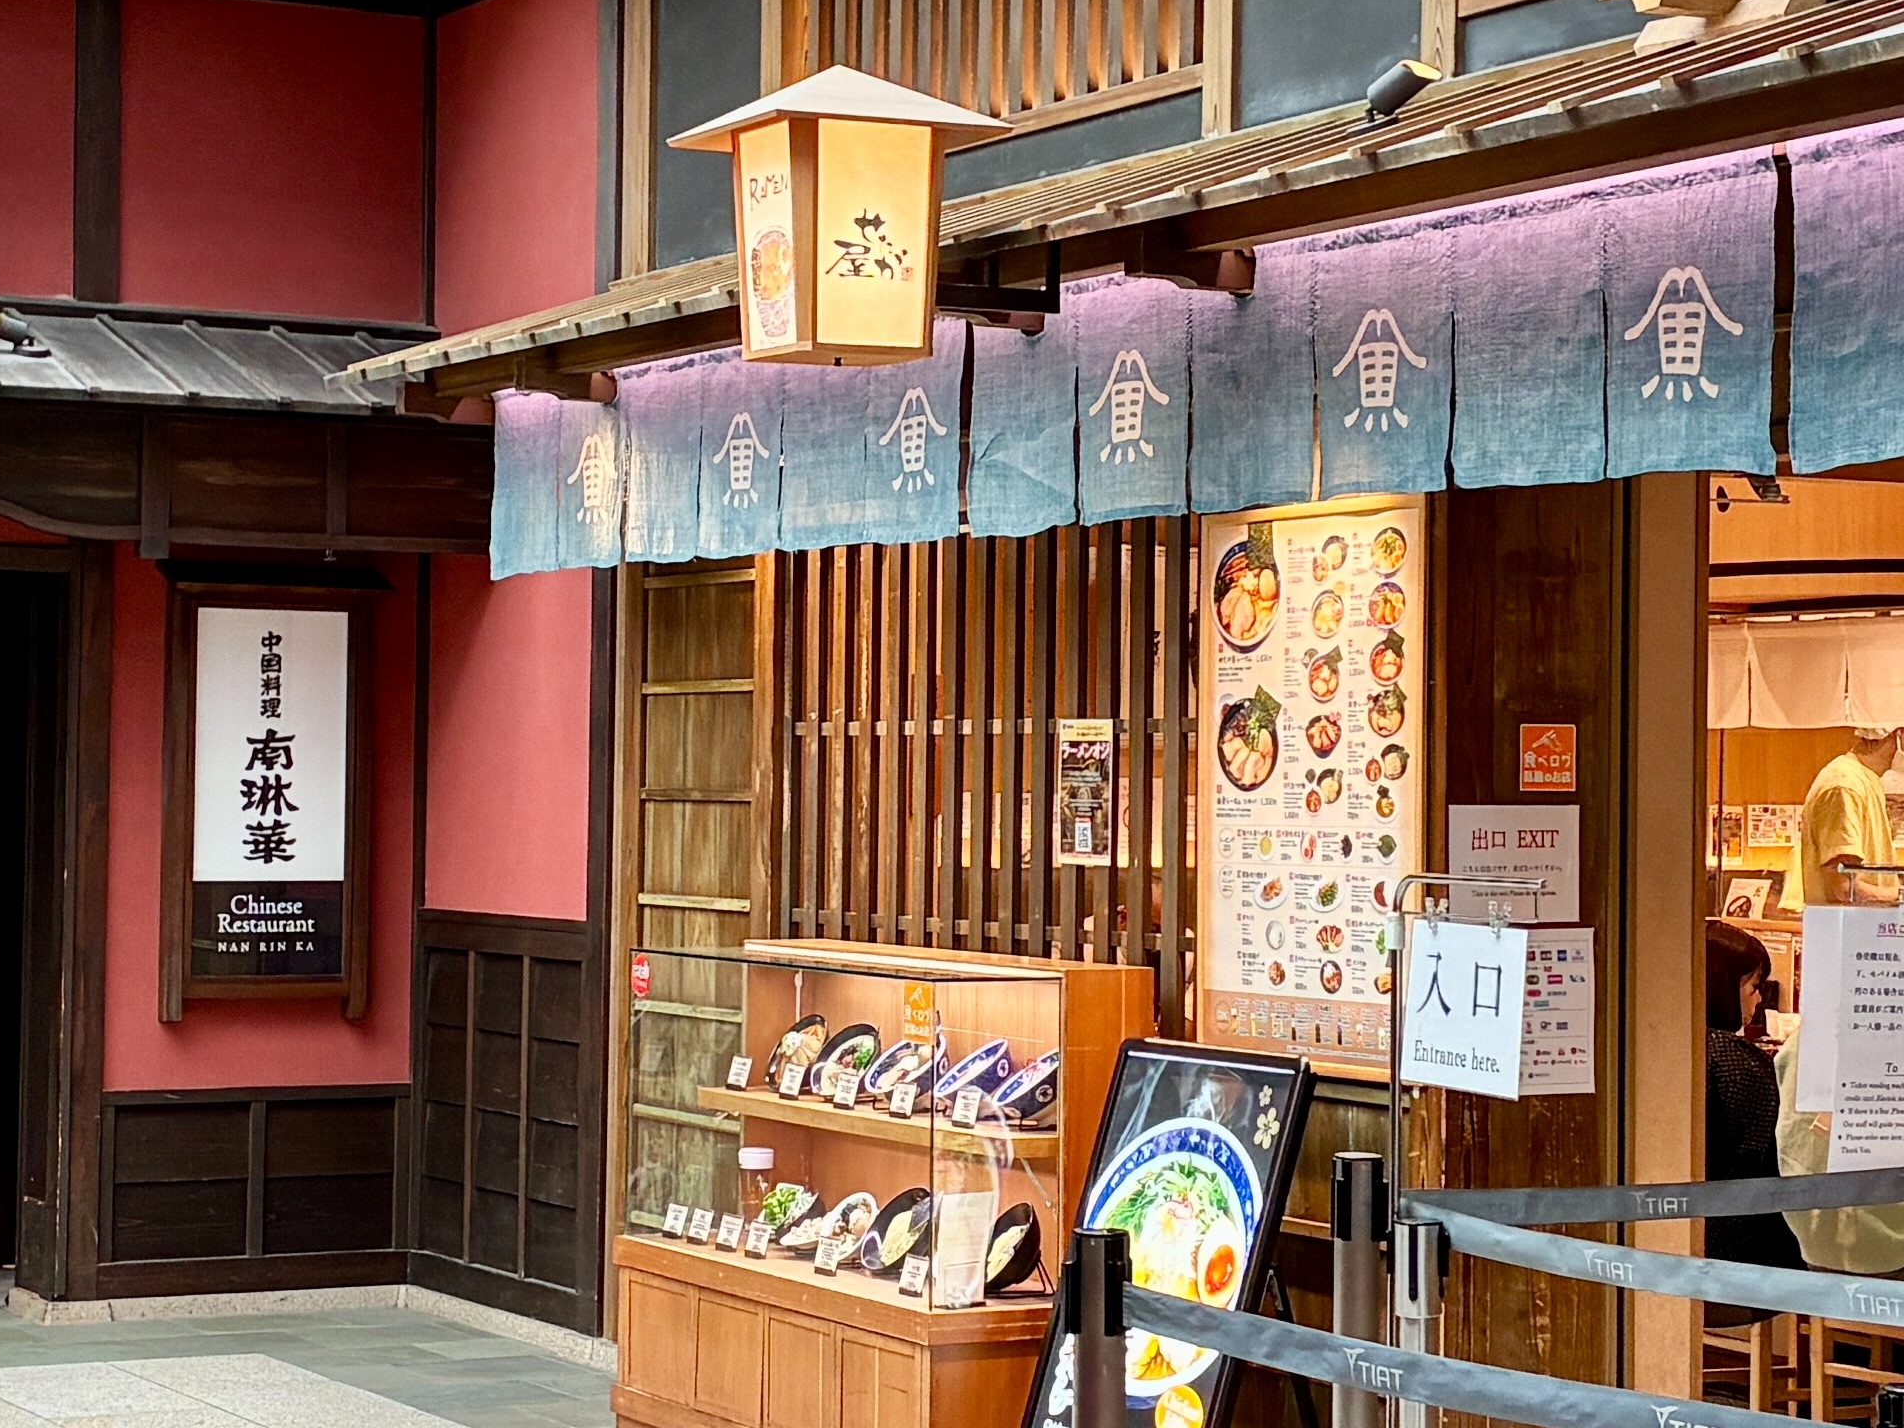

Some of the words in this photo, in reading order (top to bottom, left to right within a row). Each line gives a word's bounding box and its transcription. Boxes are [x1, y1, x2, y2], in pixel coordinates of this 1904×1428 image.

[261, 631, 282, 719] 中国料理
[1524, 751, 1572, 768] 食べログ
[240, 728, 299, 864] 南琳華
[1472, 828, 1506, 850] 出口
[1517, 830, 1559, 848] EXIT
[230, 895, 302, 915] Chinese
[218, 914, 315, 933] Restaurant
[218, 942, 250, 953] NAN
[260, 941, 287, 952] RIN
[296, 941, 314, 952] KA
[1417, 952, 1502, 1017] 入口
[1414, 1041, 1466, 1069] Entrance
[1472, 1047, 1500, 1073] here.
[1885, 1062, 1898, 1073] To
[1646, 1196, 1689, 1215] TIAT
[1594, 1258, 1634, 1282] TIAT
[1855, 1294, 1904, 1318] TIAT
[1357, 1360, 1403, 1391] TIAT
